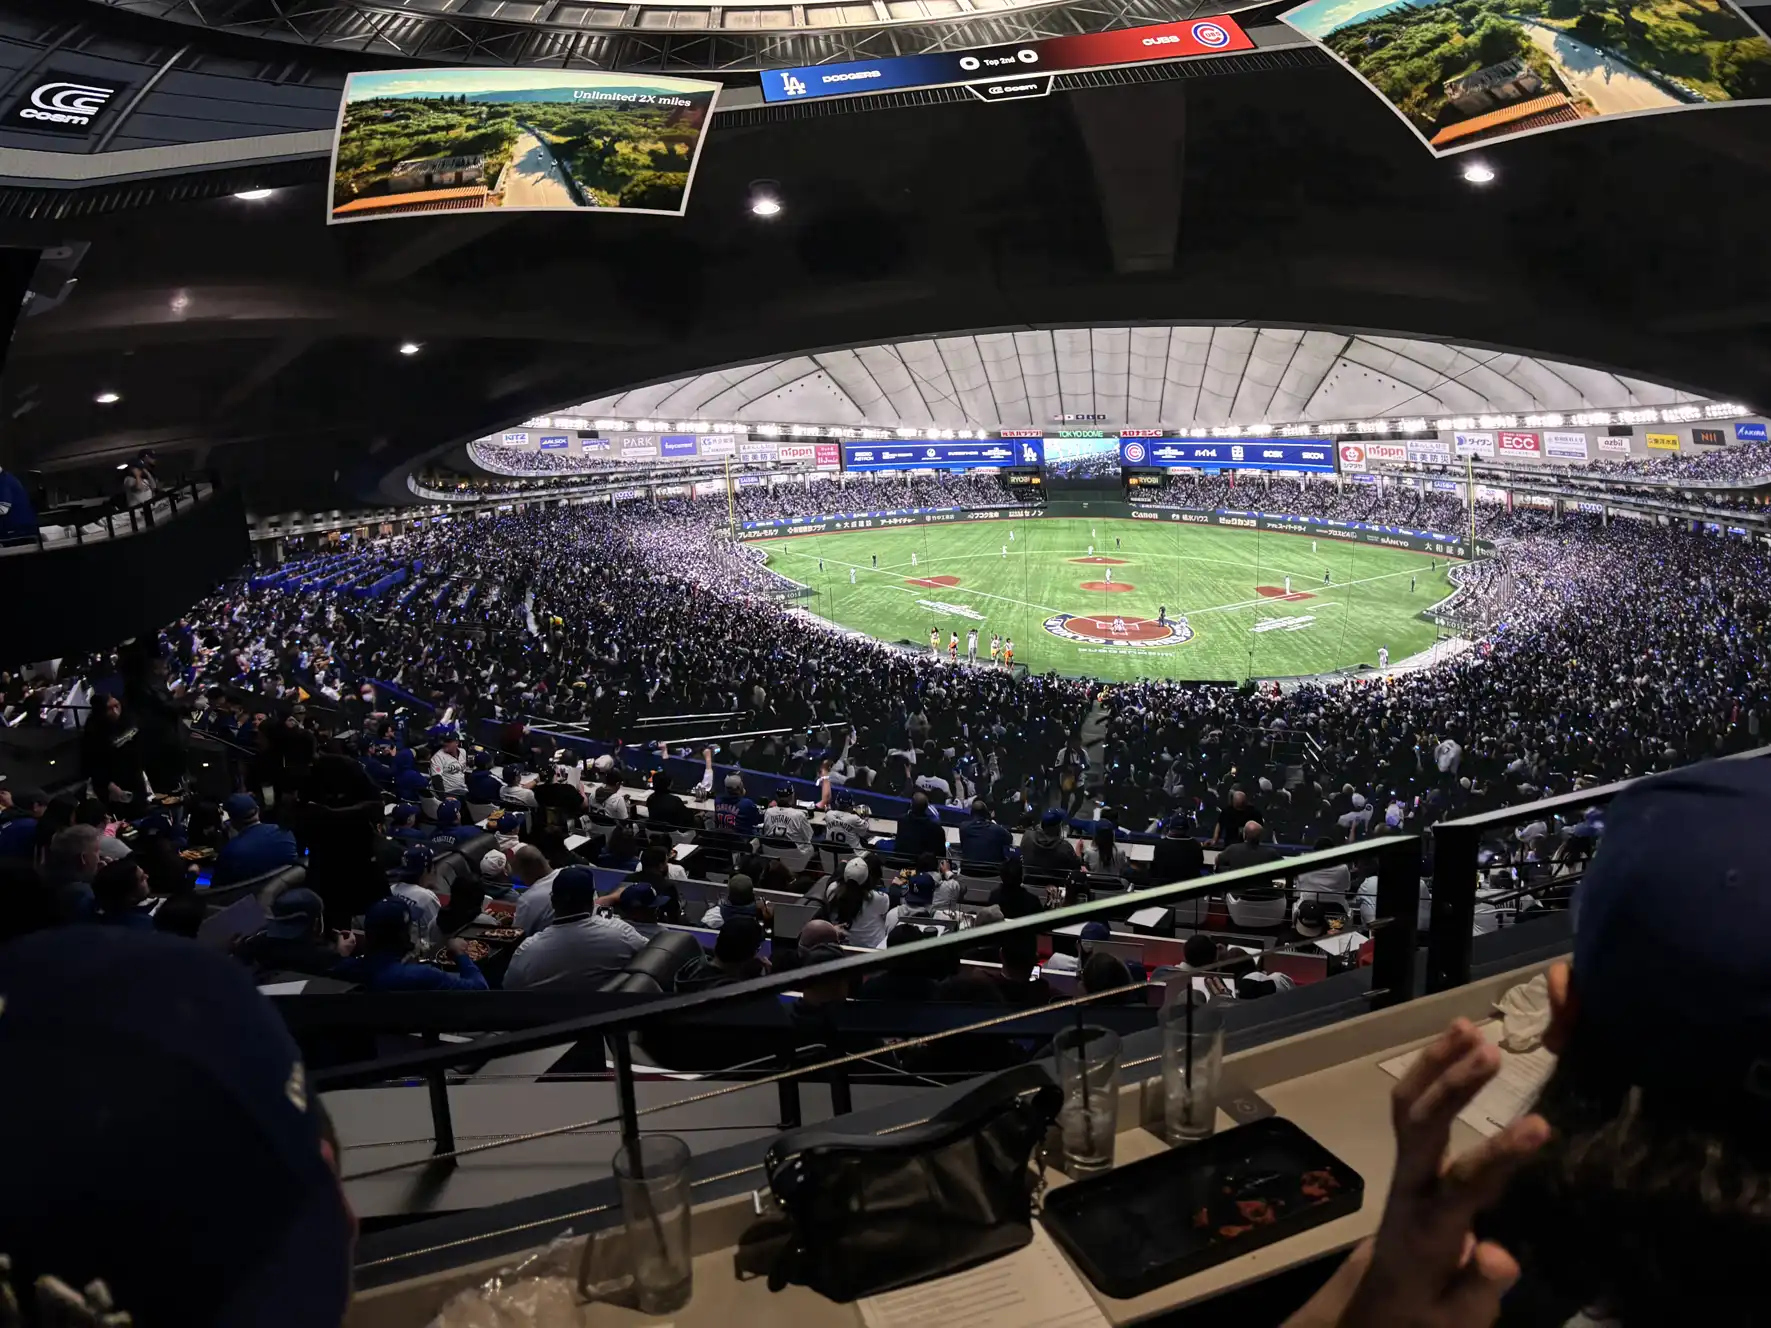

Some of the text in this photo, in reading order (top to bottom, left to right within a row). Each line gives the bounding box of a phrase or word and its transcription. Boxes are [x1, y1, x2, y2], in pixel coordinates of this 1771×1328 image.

[1142, 35, 1180, 46] CUBS
[1000, 56, 1016, 64] 2nd
[1017, 49, 1039, 64] 0
[959, 56, 980, 71] 0
[821, 70, 882, 83] DODGERS
[780, 72, 807, 96] LA
[573, 90, 692, 107] Unlimited 2X miles
[19, 108, 90, 125] cosm
[505, 433, 527, 441] KITZ
[1059, 430, 1104, 438] TOKYO DOME
[623, 435, 653, 448] PARK
[1503, 436, 1535, 450] ECC
[1604, 439, 1623, 447] azbil
[781, 448, 812, 457] nippn
[1022, 443, 1038, 462] LA
[1368, 445, 1404, 457] nippn
[1139, 476, 1159, 484] RYOBI
[1579, 502, 1603, 512] TOTO
[1131, 511, 1159, 519] Canon
[1380, 536, 1409, 547] SANKYO
[1424, 542, 1465, 556] 大和証券
